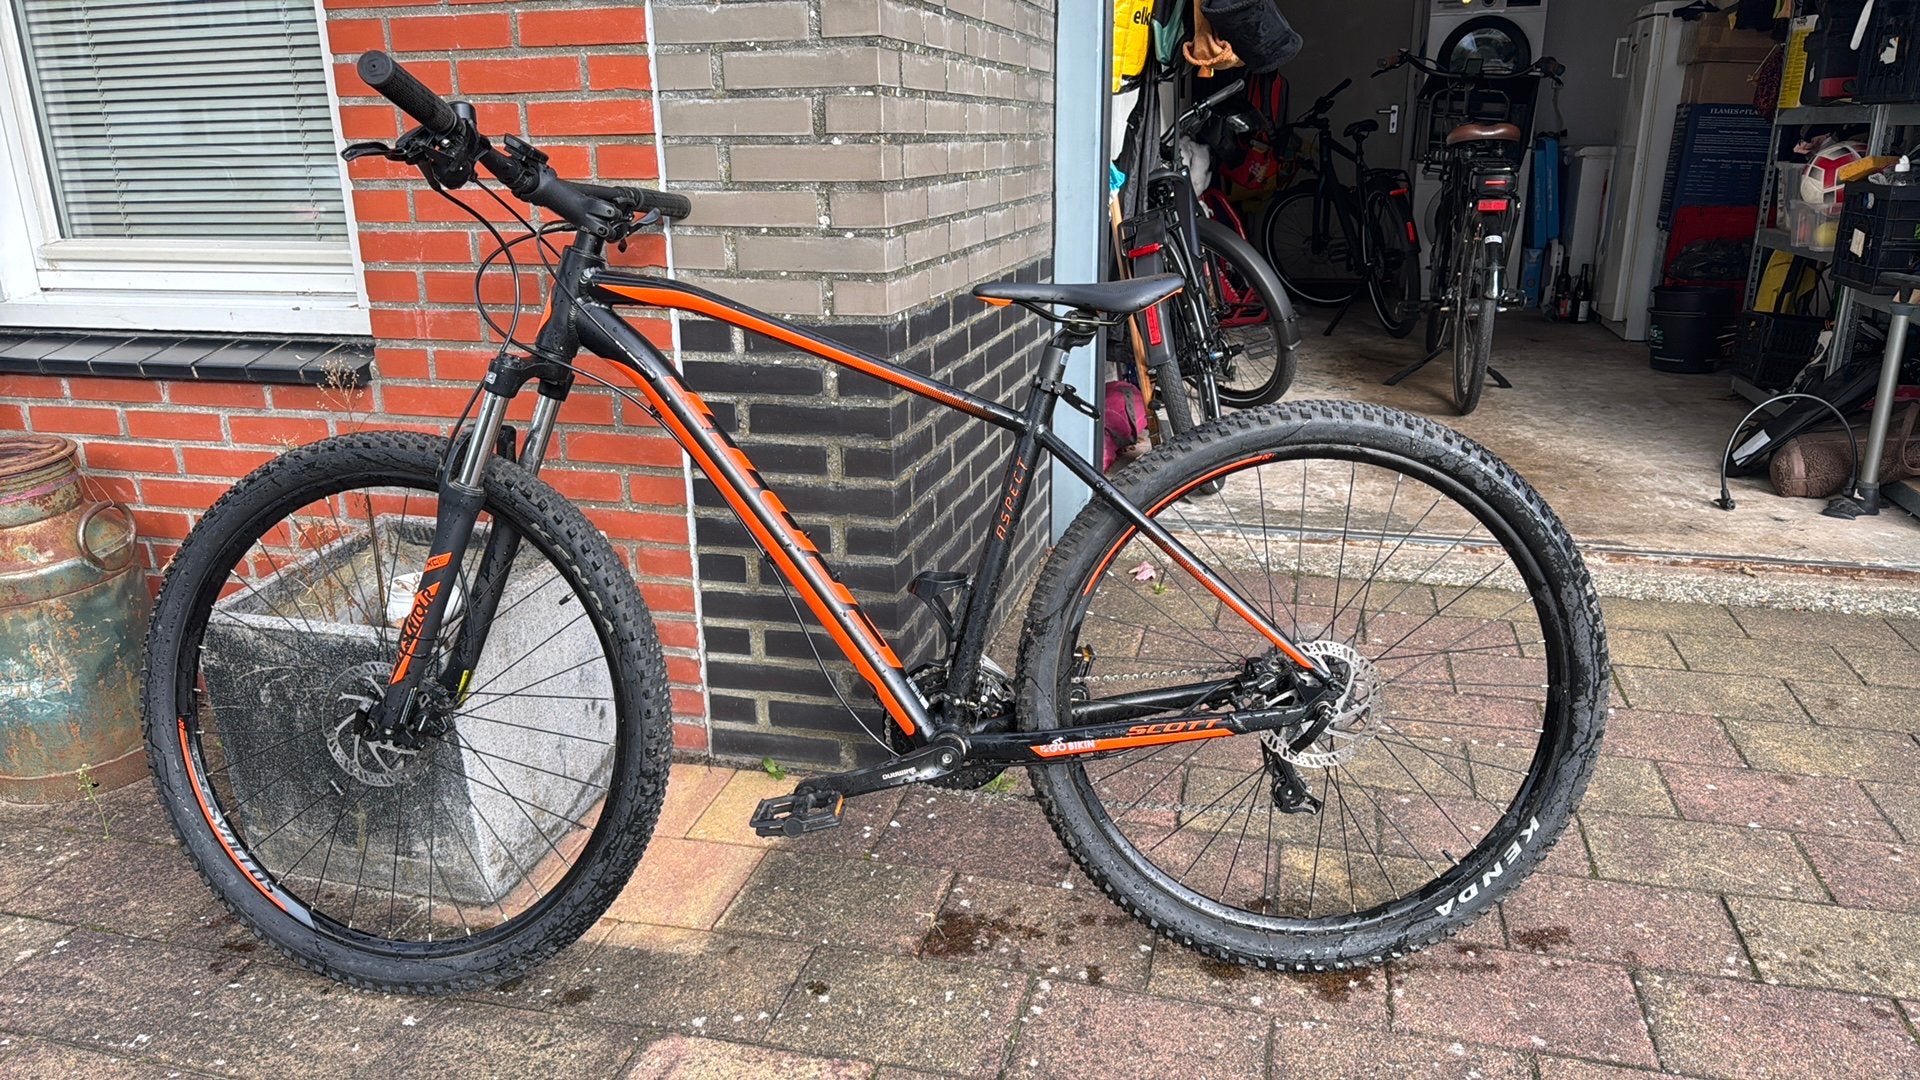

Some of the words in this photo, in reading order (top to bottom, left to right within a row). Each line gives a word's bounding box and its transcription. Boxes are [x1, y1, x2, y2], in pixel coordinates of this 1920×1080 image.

[996, 456, 1028, 540] ASPECT
[1126, 718, 1222, 736] SCOTT
[1435, 815, 1540, 916] KENDA
